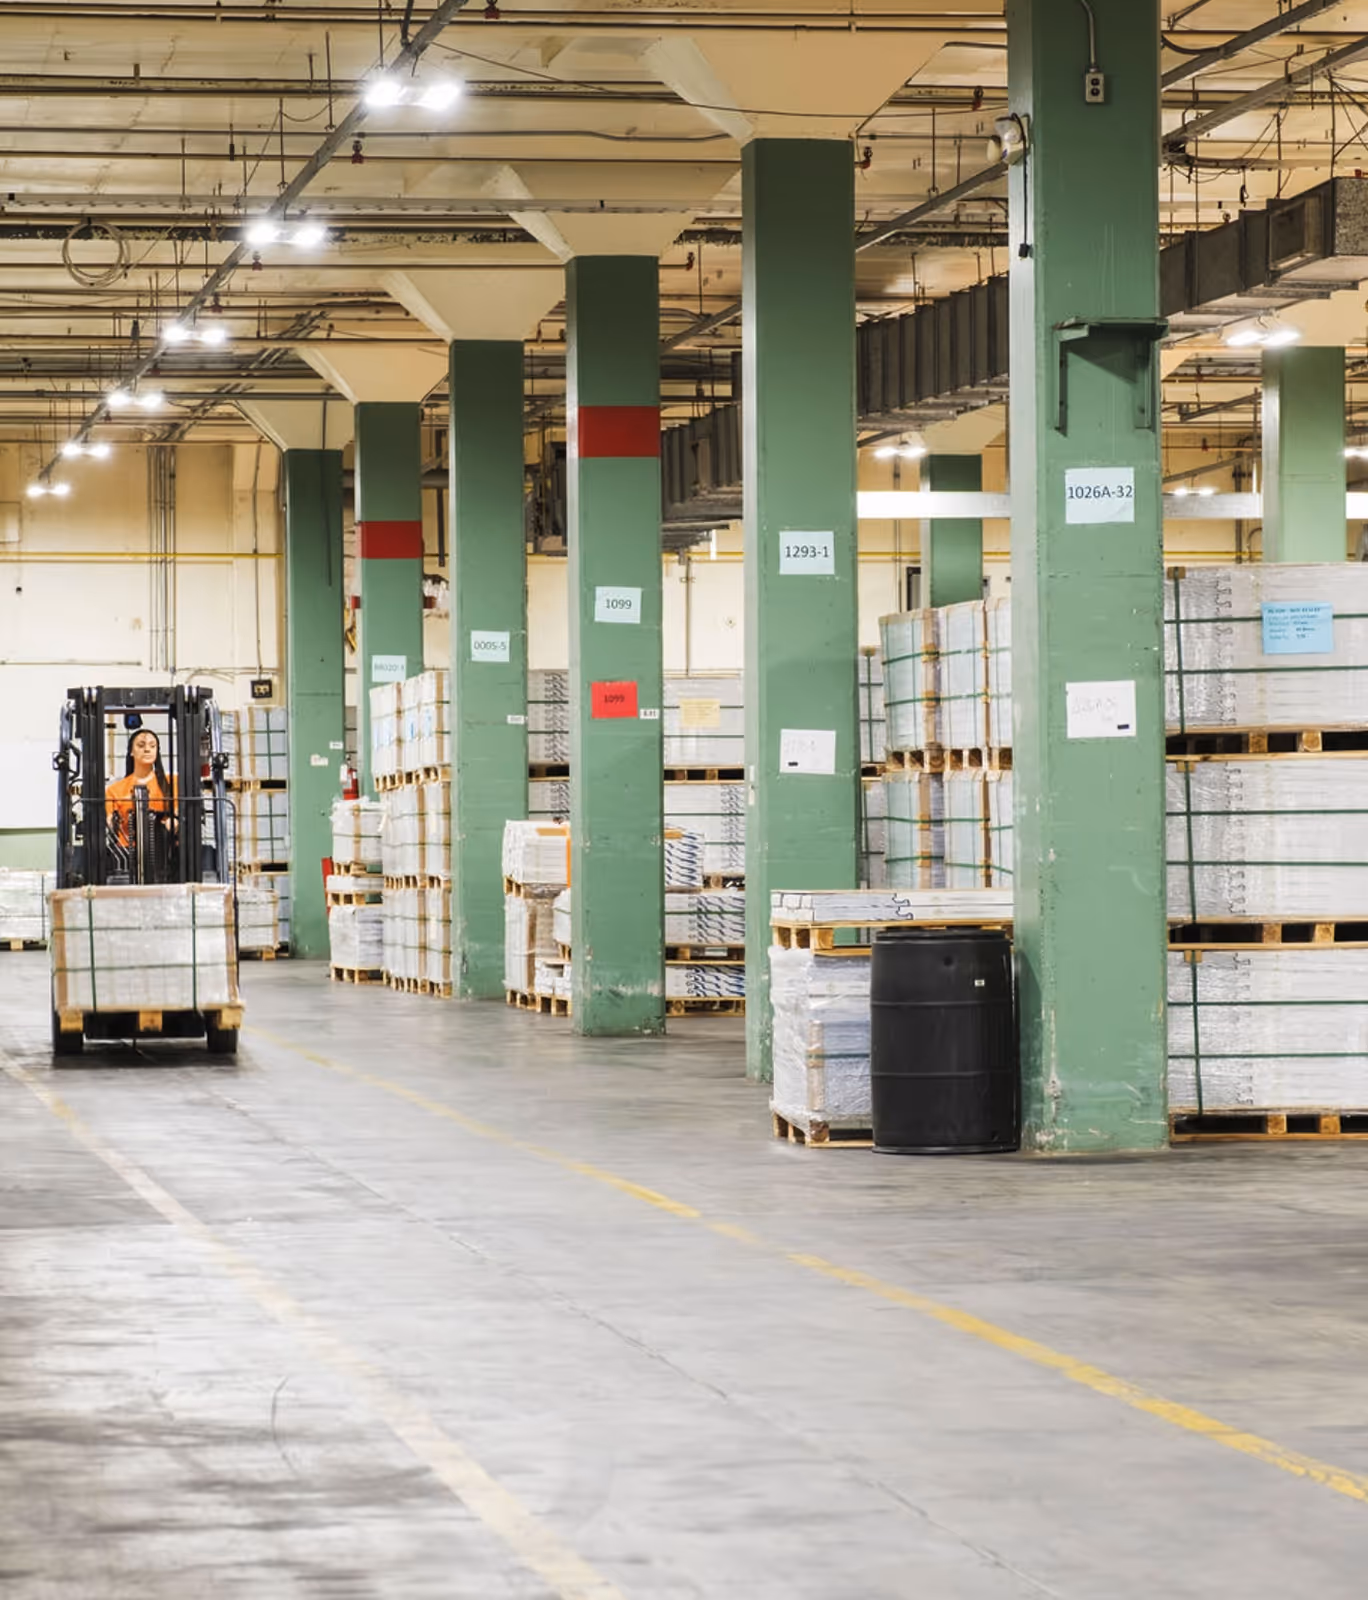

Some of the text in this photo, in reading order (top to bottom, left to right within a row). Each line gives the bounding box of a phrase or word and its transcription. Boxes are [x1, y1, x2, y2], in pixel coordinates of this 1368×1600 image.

[1068, 485, 1133, 499] 1026A-32
[785, 545, 829, 558] 1293-1
[605, 599, 632, 610] 1099
